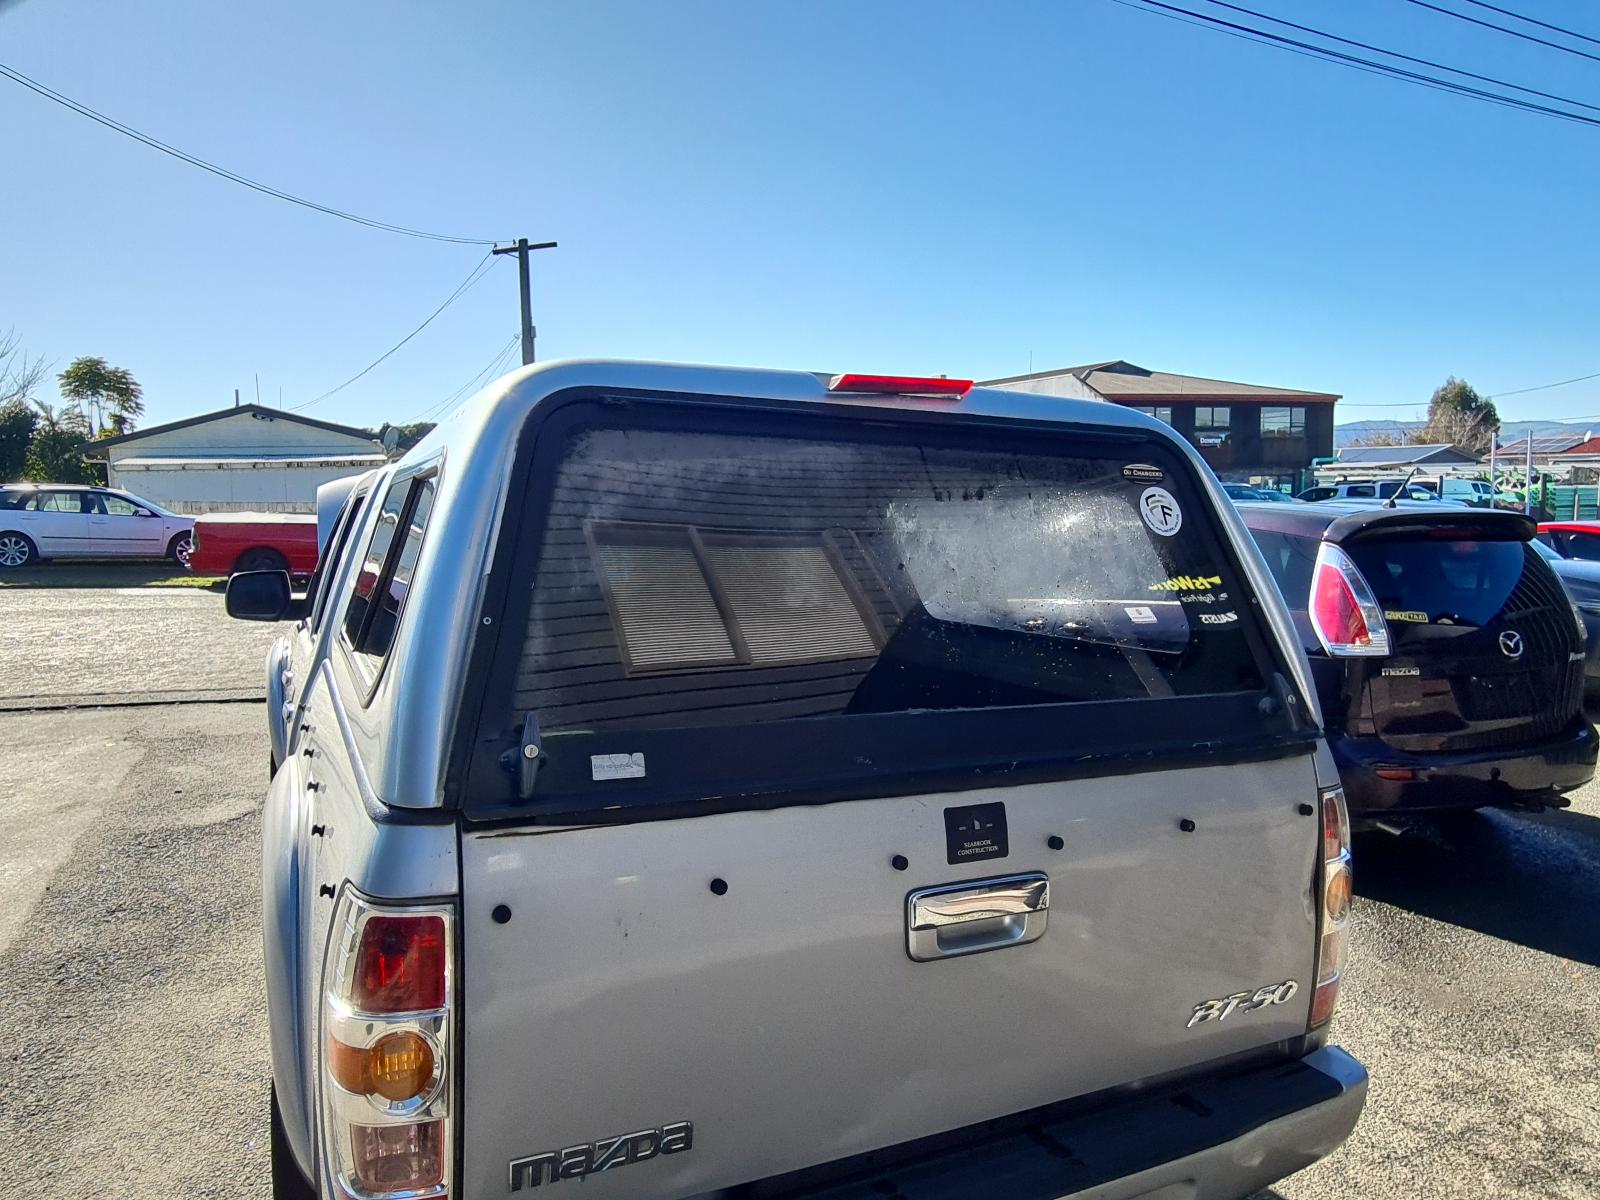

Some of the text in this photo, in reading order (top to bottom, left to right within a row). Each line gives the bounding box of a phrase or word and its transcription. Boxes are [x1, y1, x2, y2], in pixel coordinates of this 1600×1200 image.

[964, 839, 992, 848] SEABROOK
[957, 845, 999, 856] CONSTRUCTION
[1186, 980, 1299, 1028] BT-50
